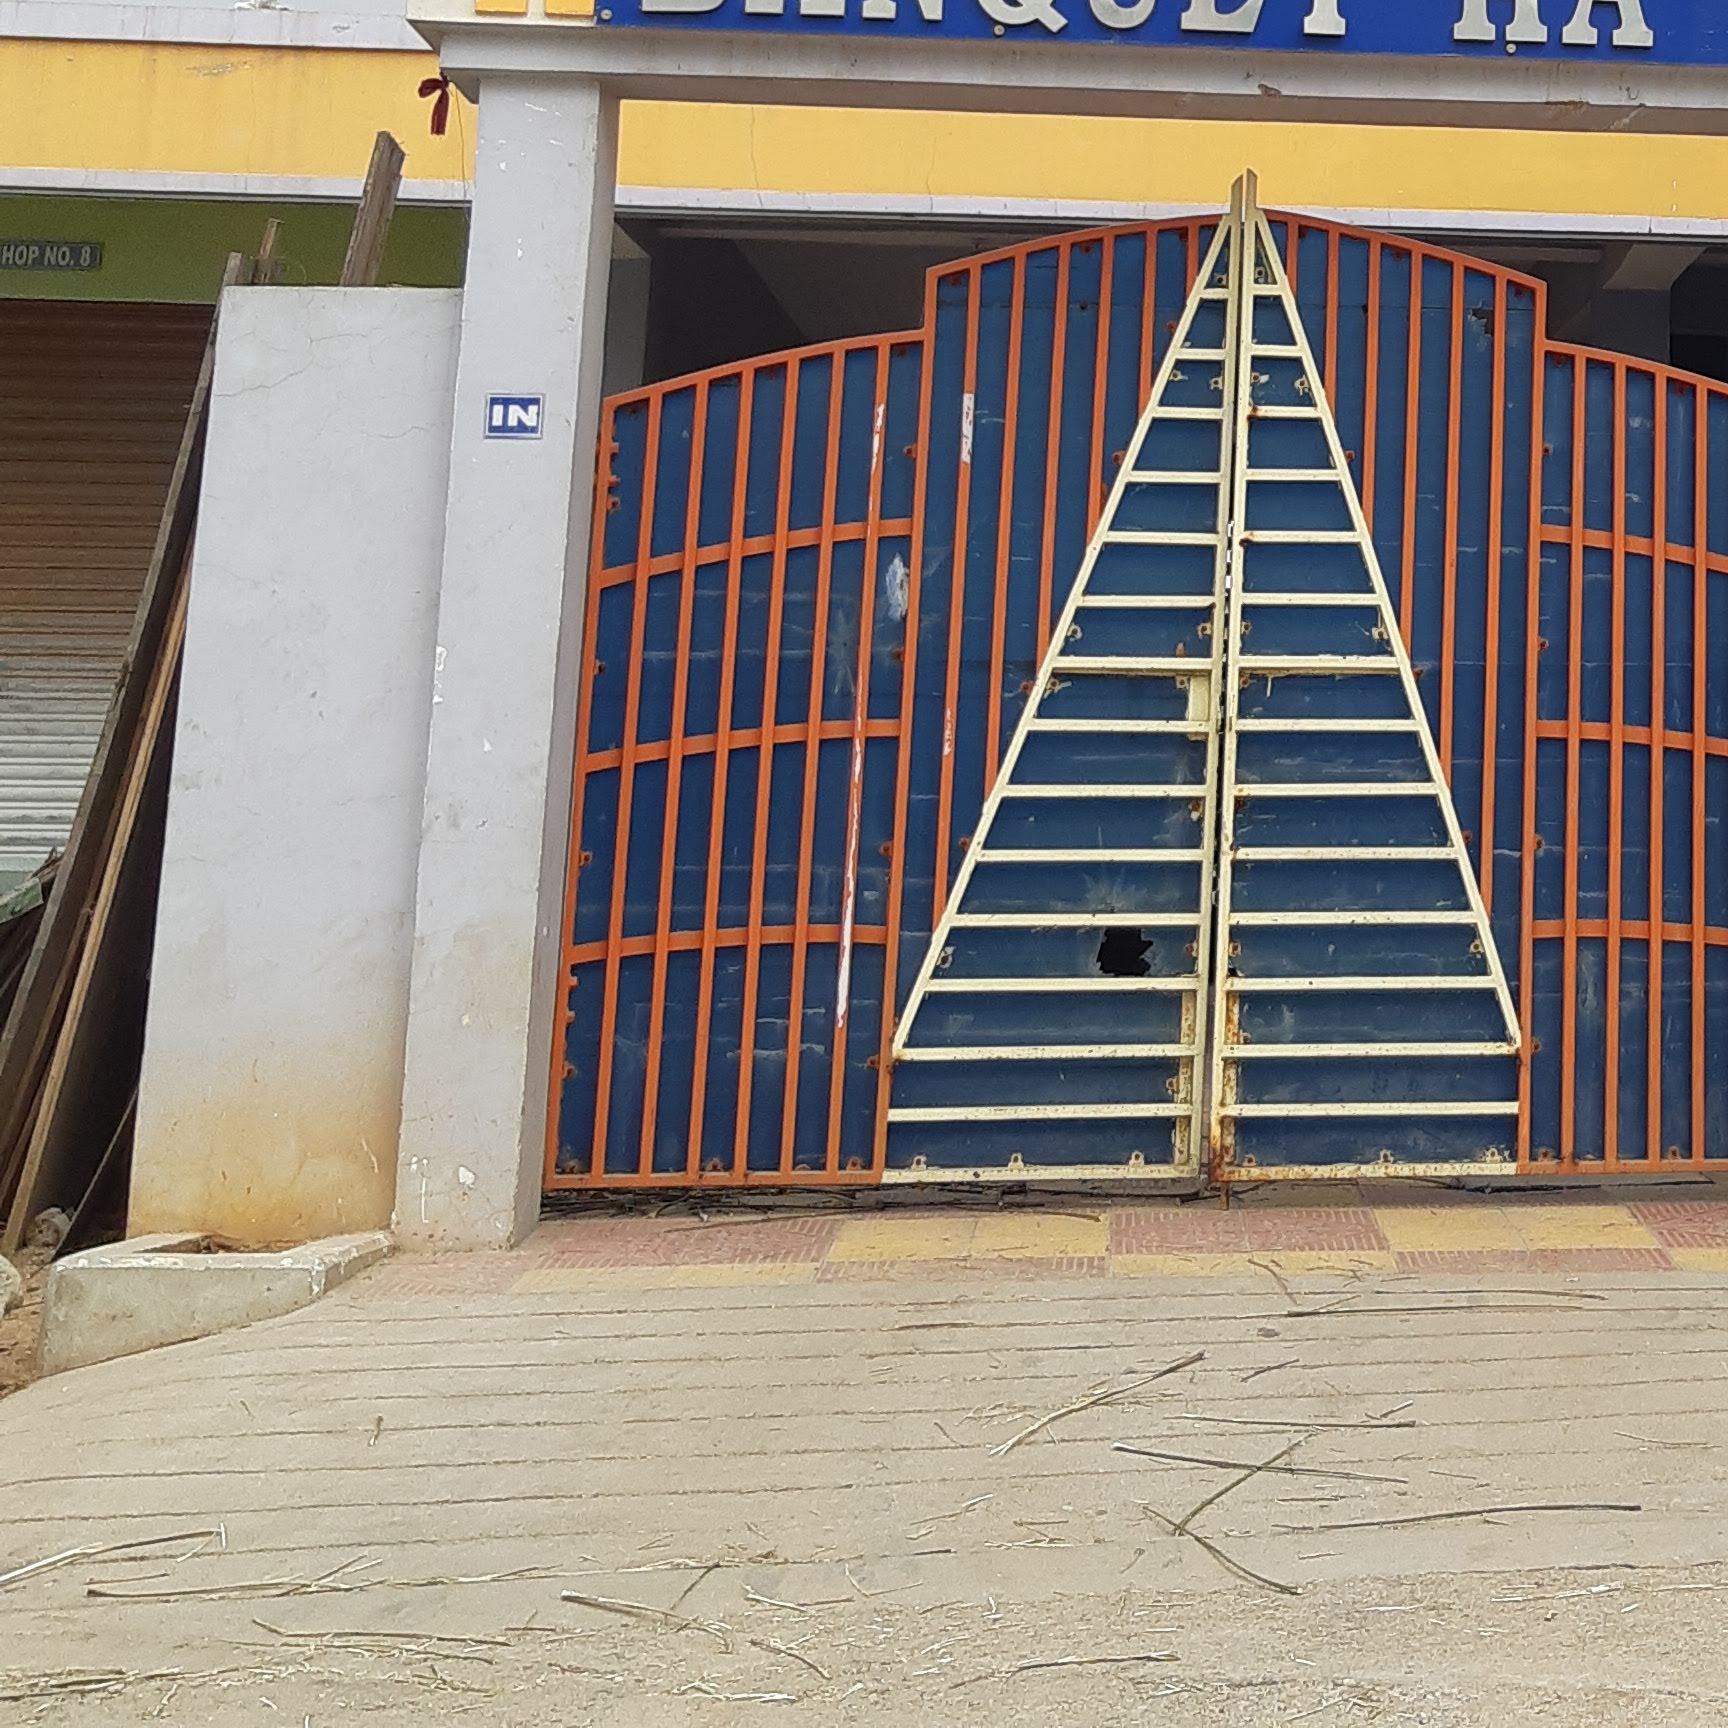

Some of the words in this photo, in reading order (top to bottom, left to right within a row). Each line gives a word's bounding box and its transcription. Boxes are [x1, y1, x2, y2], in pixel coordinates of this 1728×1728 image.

[0, 245, 40, 266] HOP
[44, 245, 74, 267] NO.
[80, 245, 91, 267] 8
[491, 404, 539, 427] IN
